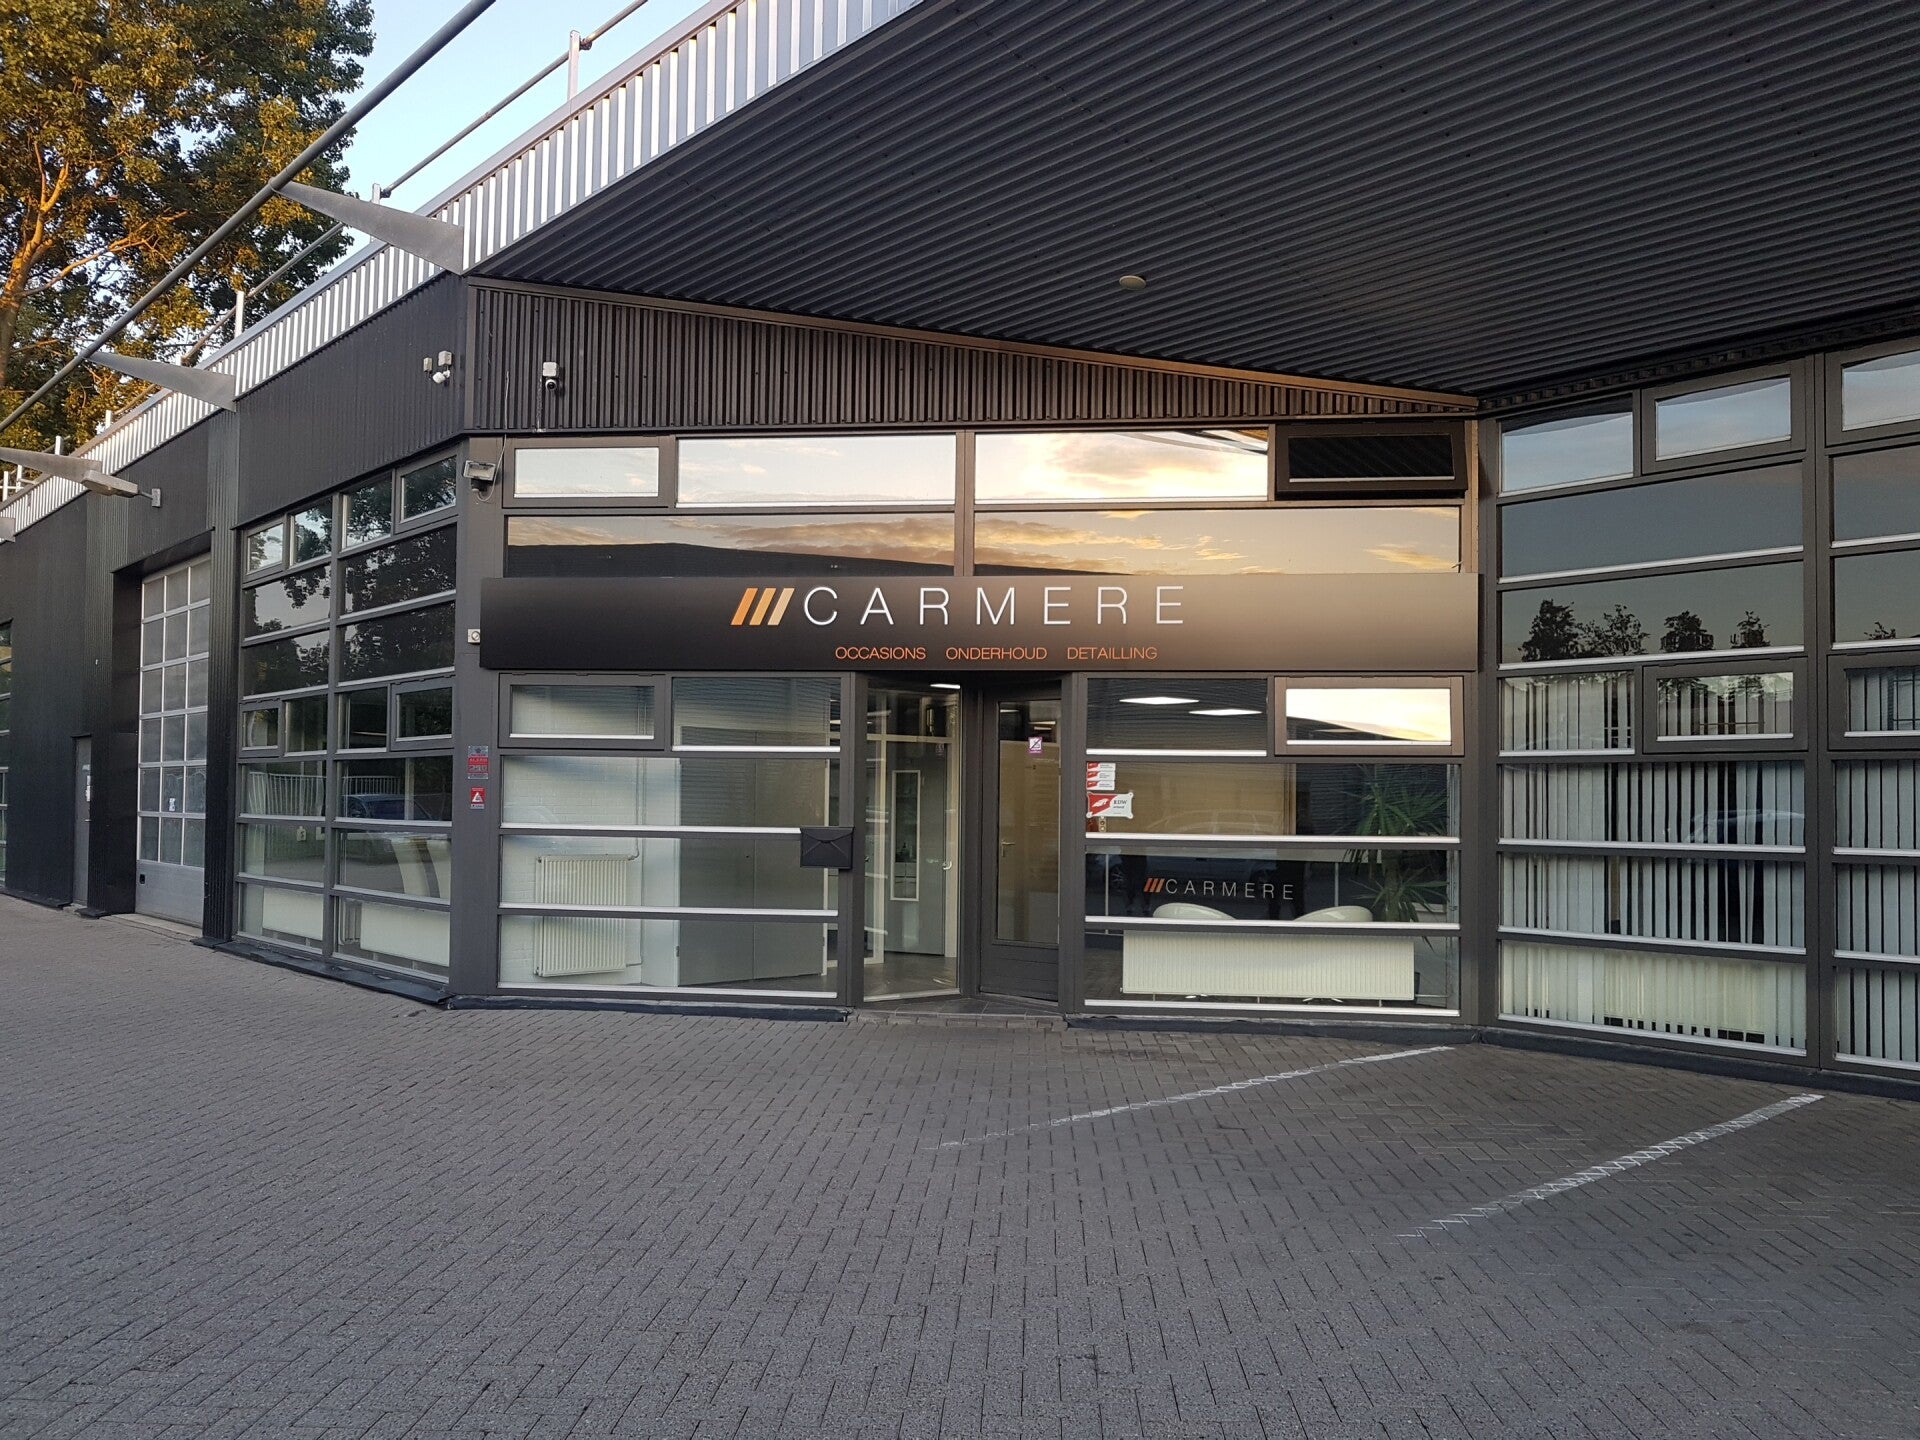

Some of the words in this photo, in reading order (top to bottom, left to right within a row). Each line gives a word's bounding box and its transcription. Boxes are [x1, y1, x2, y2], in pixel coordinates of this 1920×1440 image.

[803, 586, 1184, 626] CARMERE
[835, 646, 926, 660] OCCASIONS
[945, 646, 1048, 660] ONDERHOUD
[1067, 646, 1158, 660] DETAILLING
[1165, 878, 1294, 900] CARMERE
